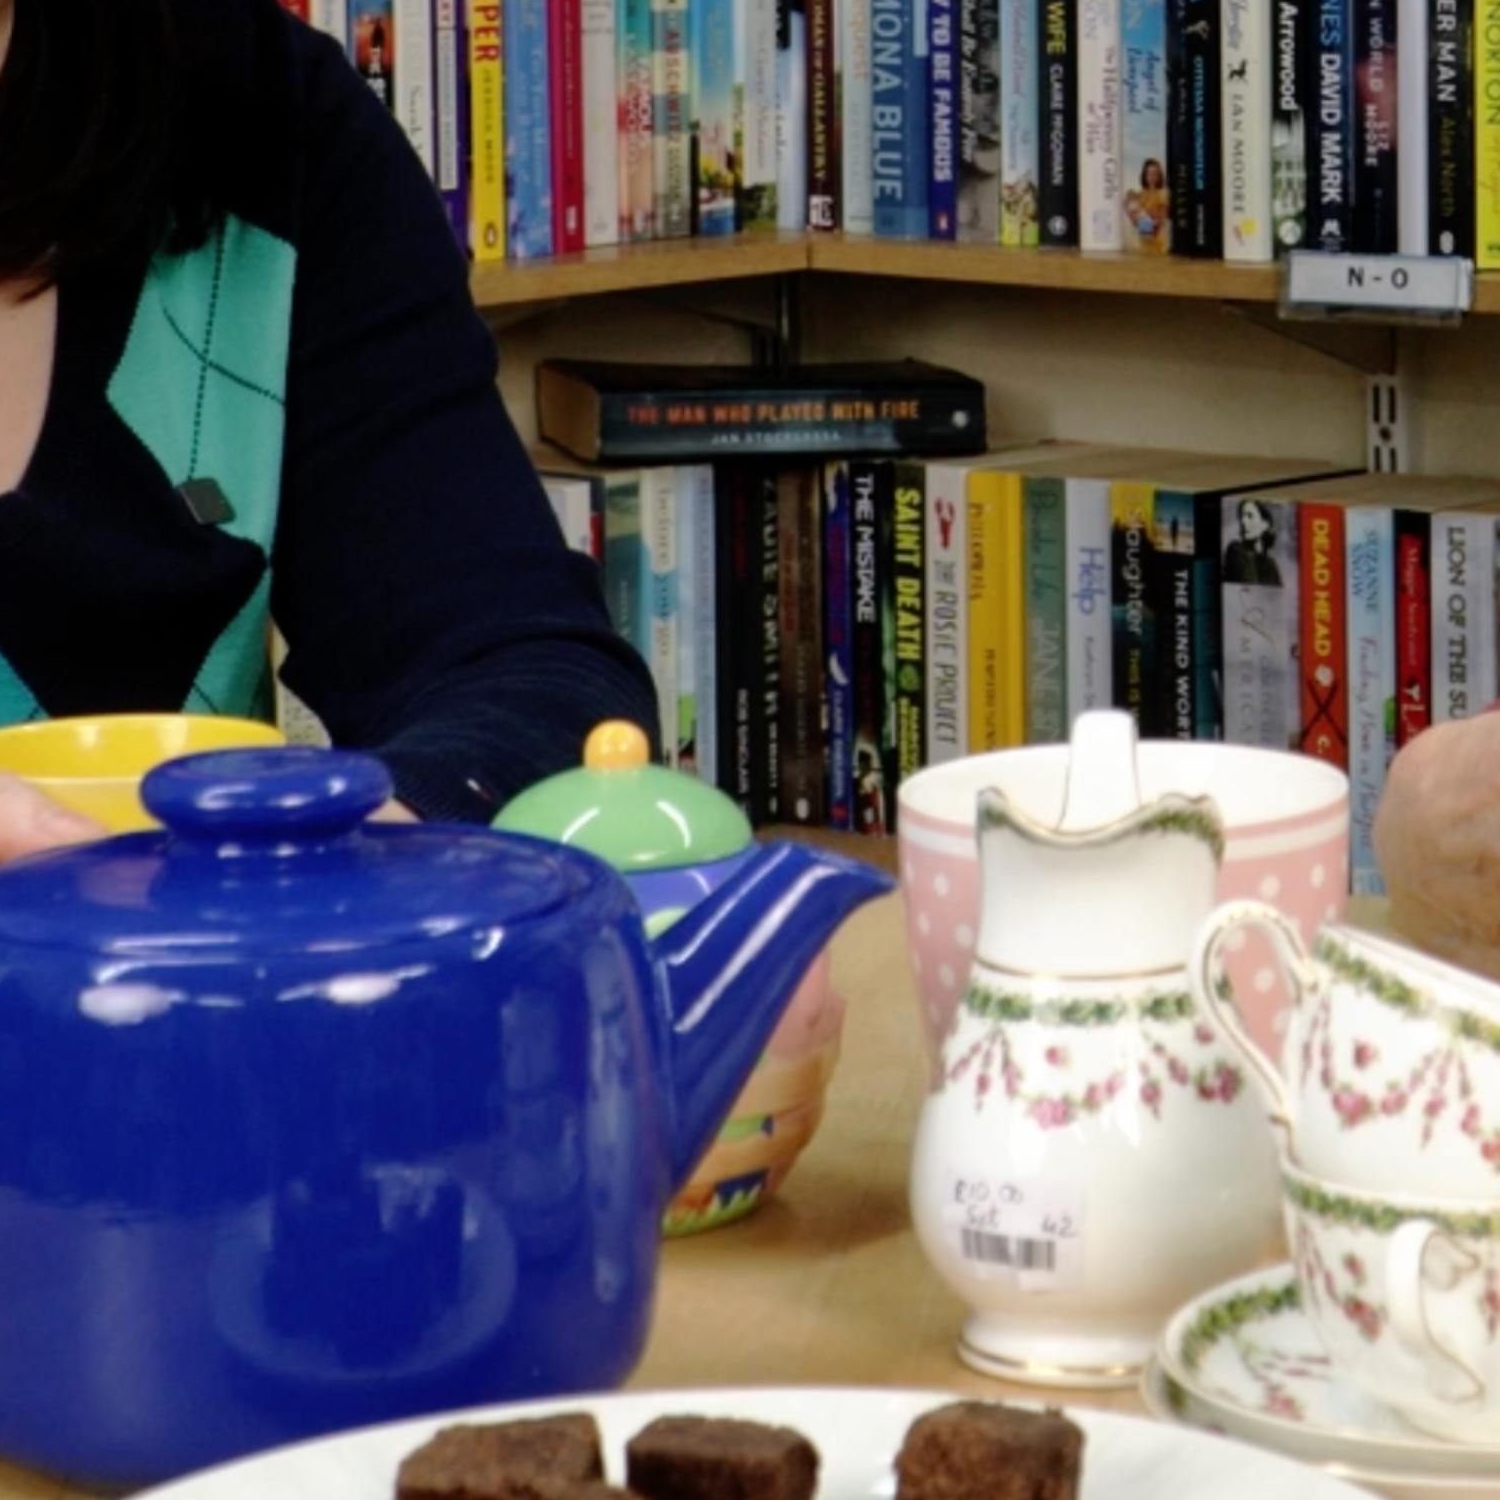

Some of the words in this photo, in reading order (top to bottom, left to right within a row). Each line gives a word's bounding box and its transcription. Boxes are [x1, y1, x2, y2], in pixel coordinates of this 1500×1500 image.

[931, 13, 952, 46] TO
[1047, 0, 1067, 54] WIFE
[1279, 1, 1300, 112] Arrowood
[1368, 15, 1386, 92] WORLD
[932, 52, 952, 82] BE
[1319, 51, 1343, 126] DAVID
[1436, 40, 1458, 102] MAN
[872, 102, 904, 200] BLUE
[931, 87, 954, 182] FAMOUS
[1320, 131, 1343, 206] MARK
[1348, 266, 1365, 288] N
[628, 406, 659, 425] THE
[665, 404, 706, 424] MAN
[711, 404, 752, 424] WHO
[756, 403, 827, 423] PLAYED
[831, 401, 877, 421] WITH
[881, 400, 920, 420] FIRE
[855, 474, 875, 522] THE
[894, 487, 922, 567] SAINT
[856, 525, 878, 622] MISTAKE
[1071, 546, 1106, 617] Help
[1121, 504, 1147, 638] Slaughter
[1311, 518, 1332, 586] DEAD
[894, 575, 922, 660] DEATH
[932, 590, 960, 653] ROSIE
[1312, 590, 1332, 658] HEAD
[932, 663, 961, 746] PROJECT
